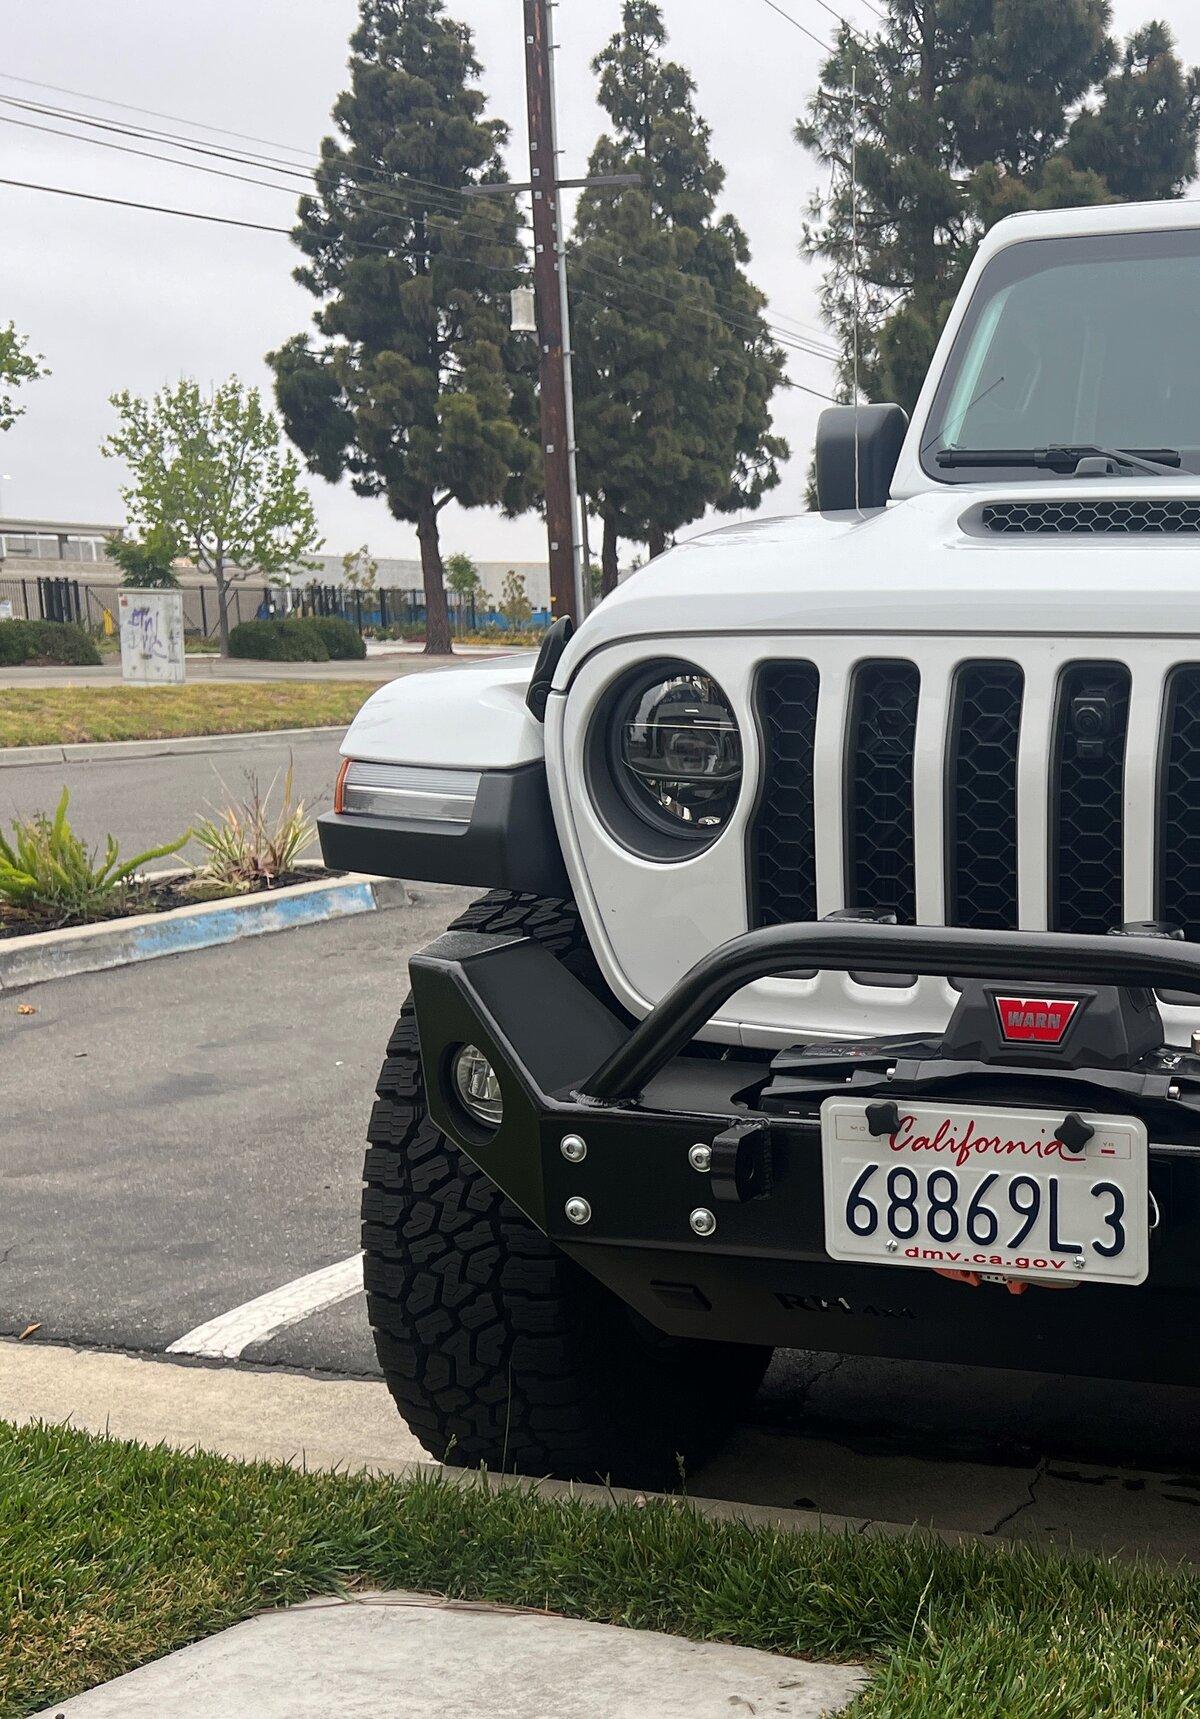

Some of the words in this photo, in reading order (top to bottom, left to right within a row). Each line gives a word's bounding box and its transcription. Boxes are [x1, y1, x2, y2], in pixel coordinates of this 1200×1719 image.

[1007, 1011, 1062, 1029] WARN
[889, 1115, 1087, 1167] California
[845, 1163, 1127, 1258] 68869L3
[904, 1246, 1067, 1269] dmv.ca.gov
